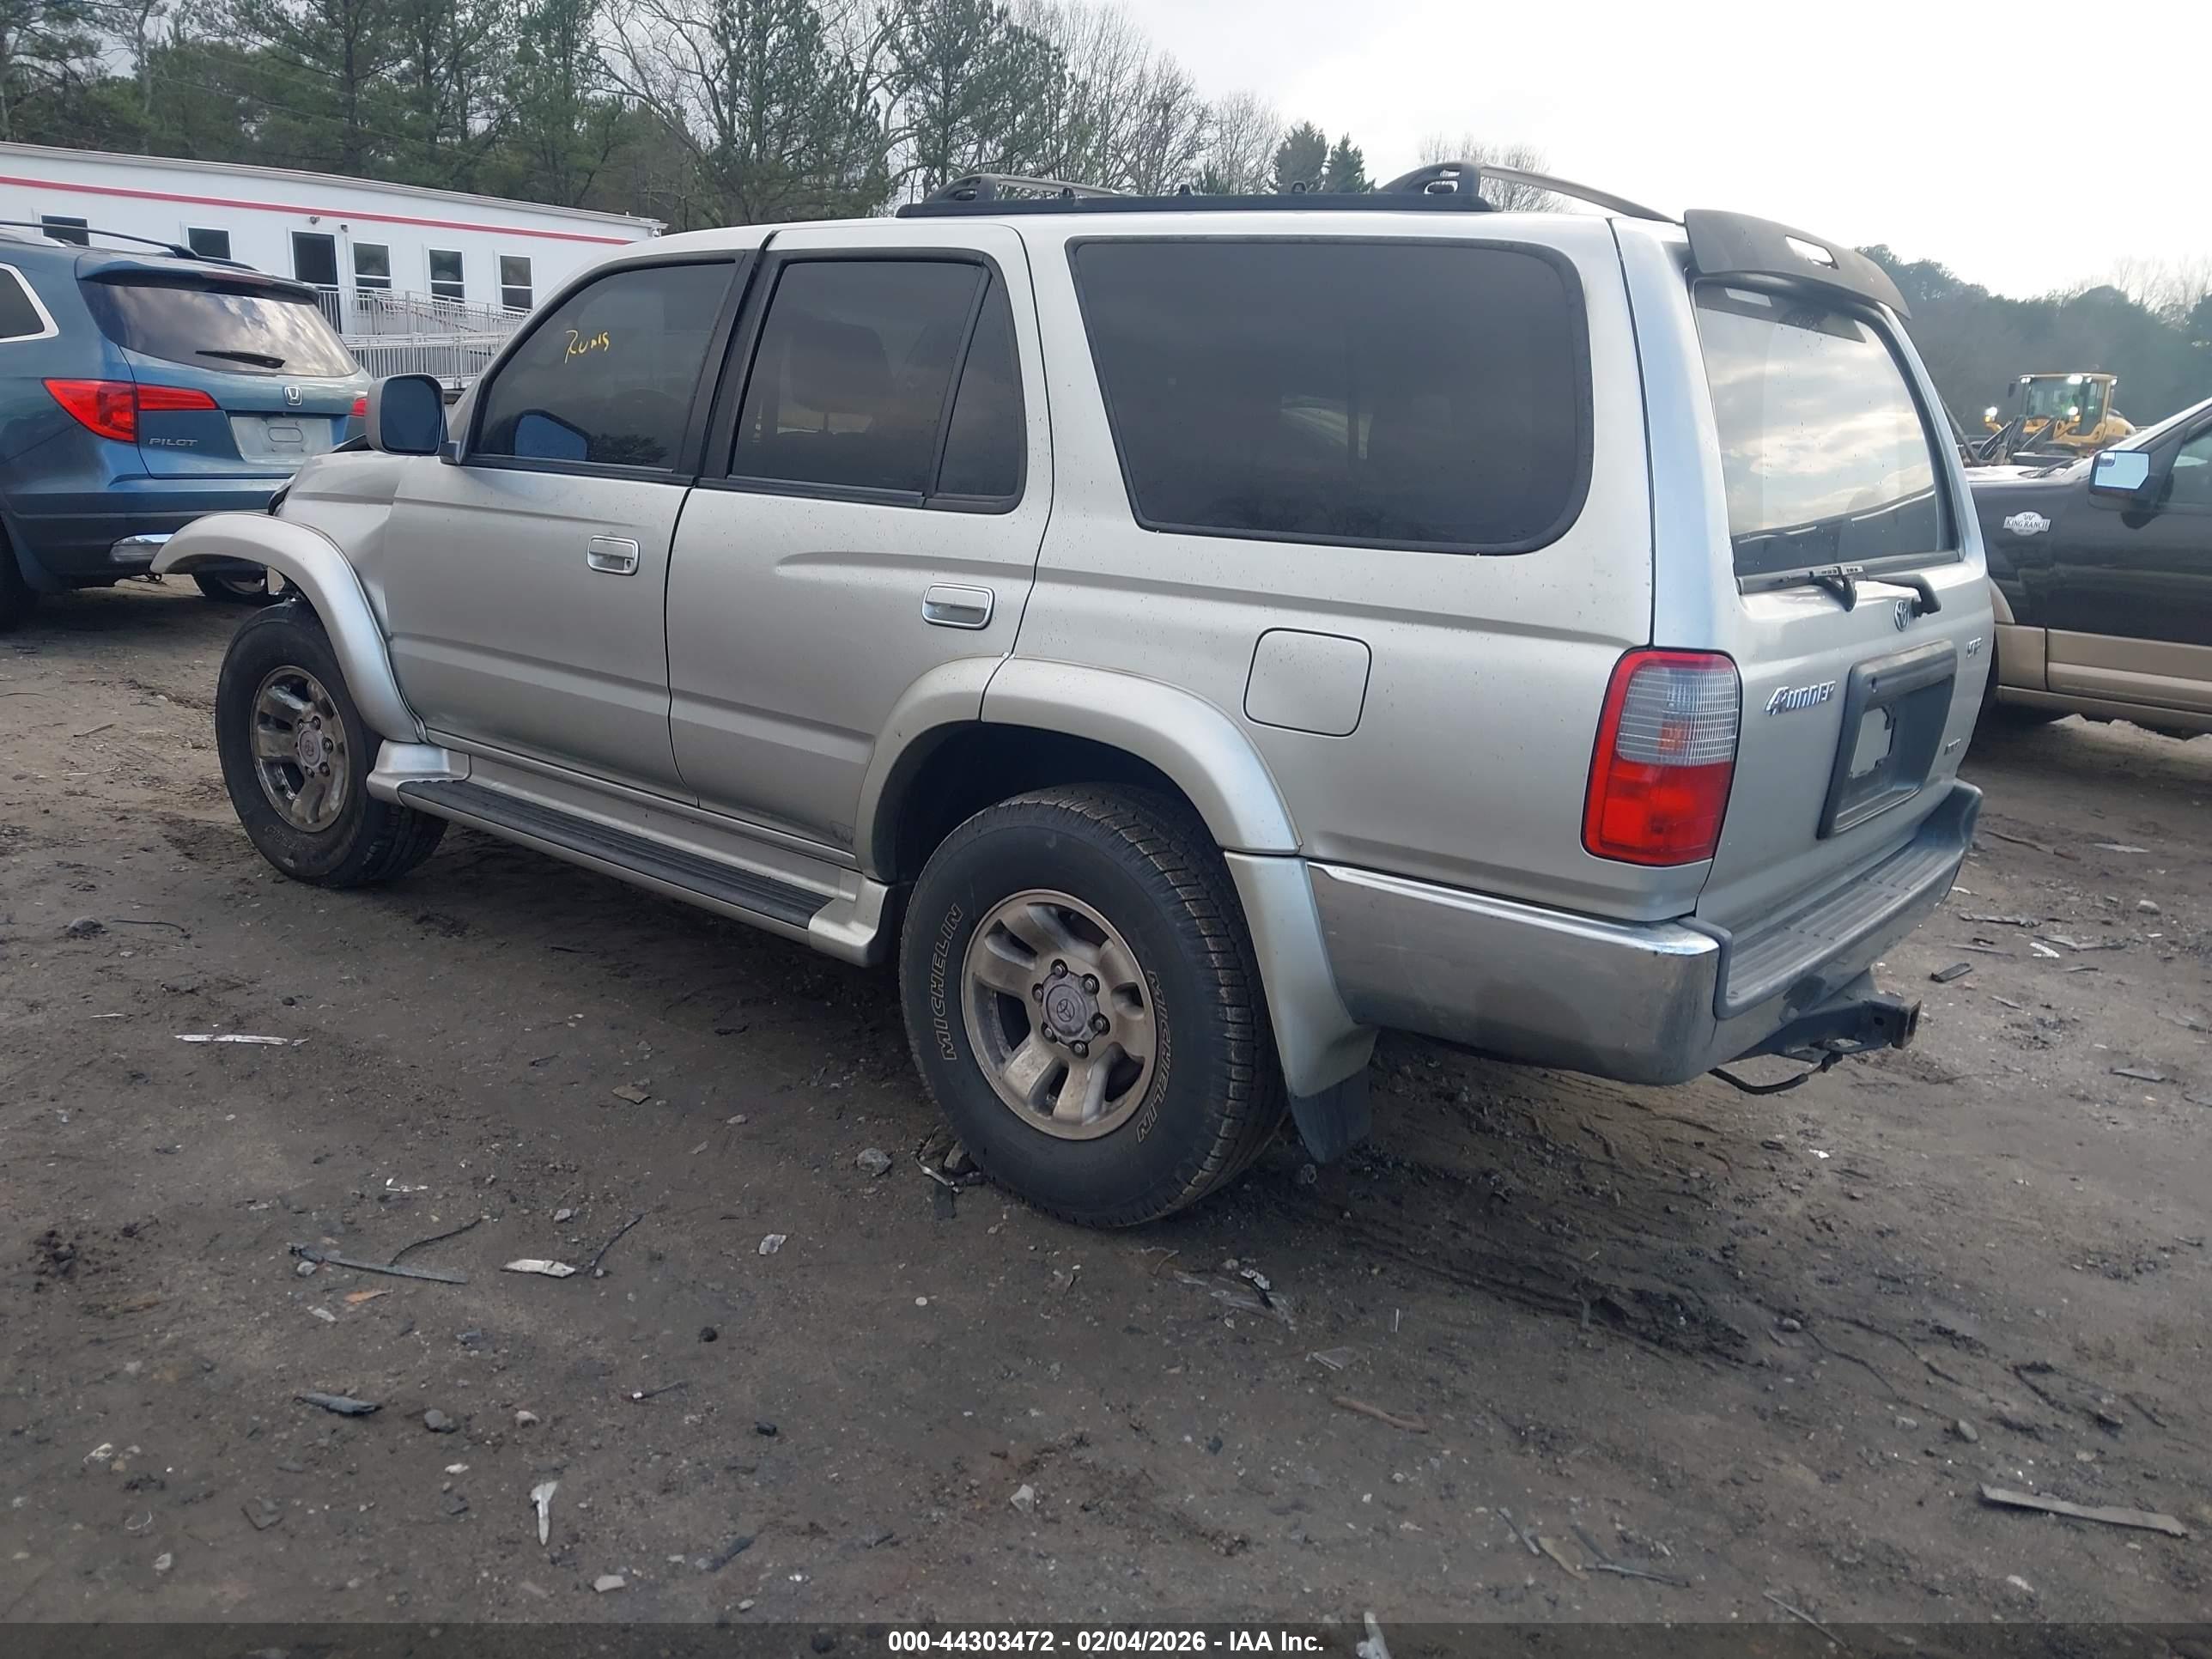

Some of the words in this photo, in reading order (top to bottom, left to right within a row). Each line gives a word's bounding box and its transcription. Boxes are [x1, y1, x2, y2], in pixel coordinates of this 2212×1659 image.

[149, 437, 199, 447] PILOT
[2006, 518, 2023, 527] KING
[2023, 520, 2049, 530] RANCH
[927, 902, 964, 1061] MICHELIN
[1135, 969, 1172, 1144] MICHELIN
